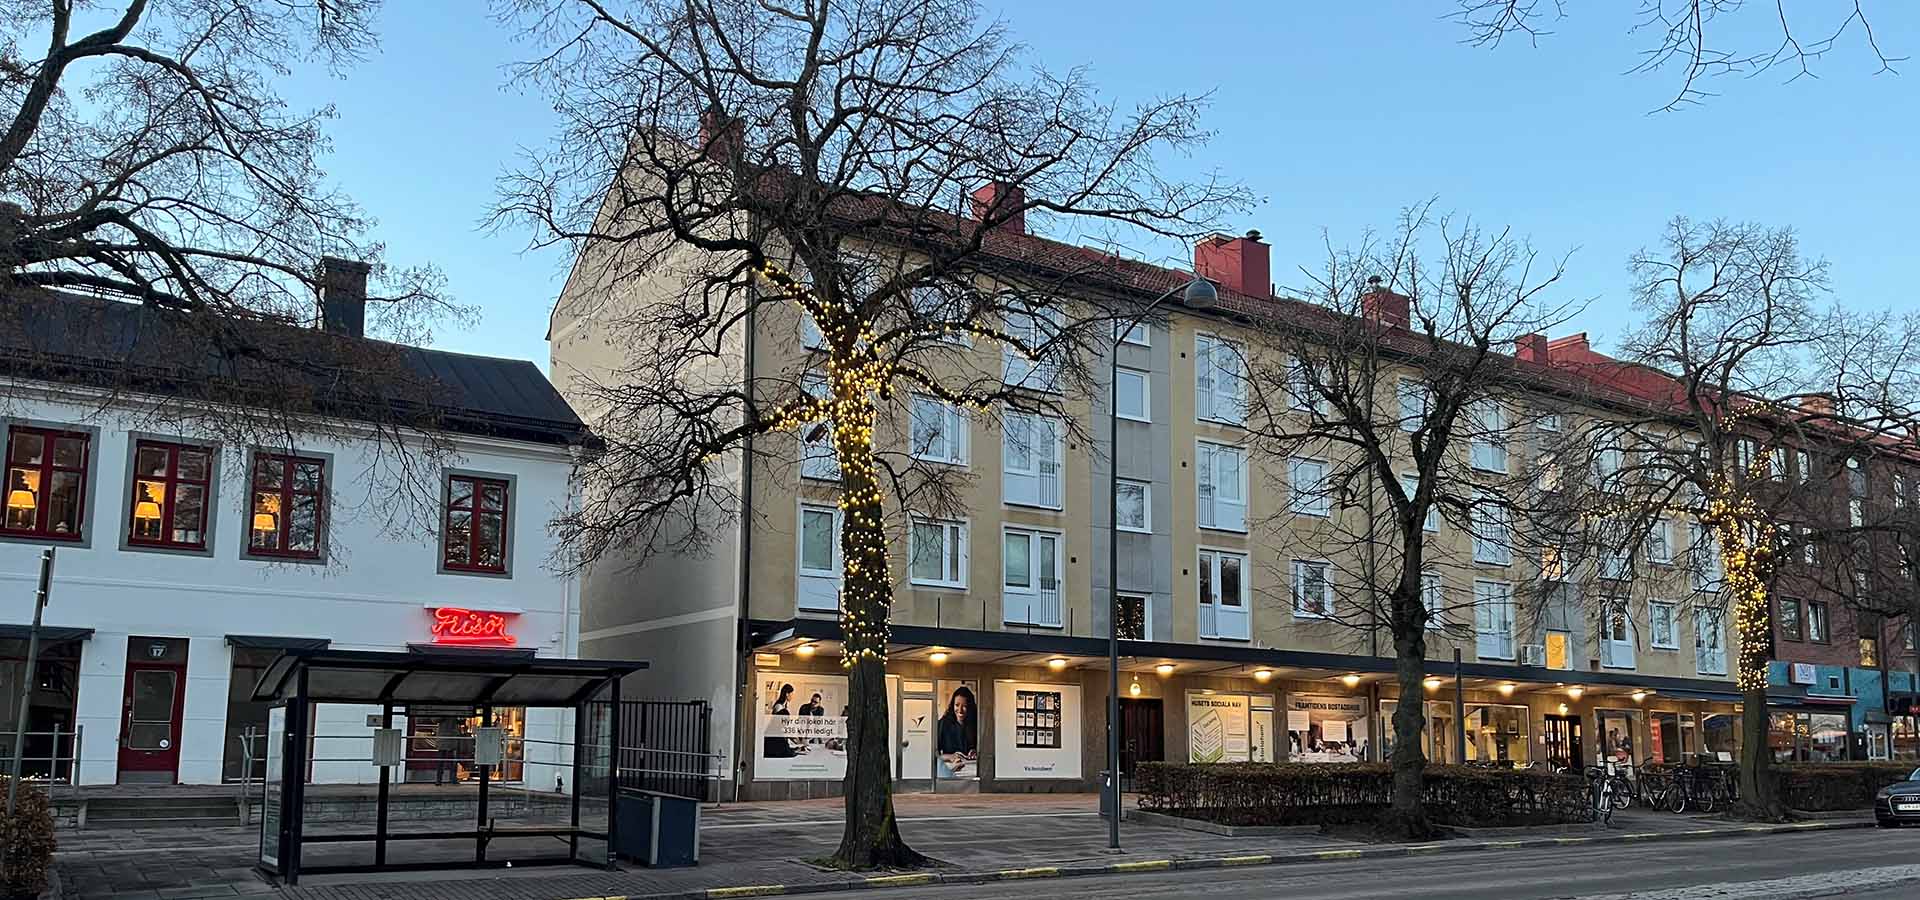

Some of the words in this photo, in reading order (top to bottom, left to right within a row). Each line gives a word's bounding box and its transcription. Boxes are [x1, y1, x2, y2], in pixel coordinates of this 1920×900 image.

[432, 608, 516, 642] Frisör
[152, 648, 164, 656] 17
[781, 718, 793, 727] Hyr
[797, 727, 813, 735] kvm
[814, 727, 834, 736] ledigt
